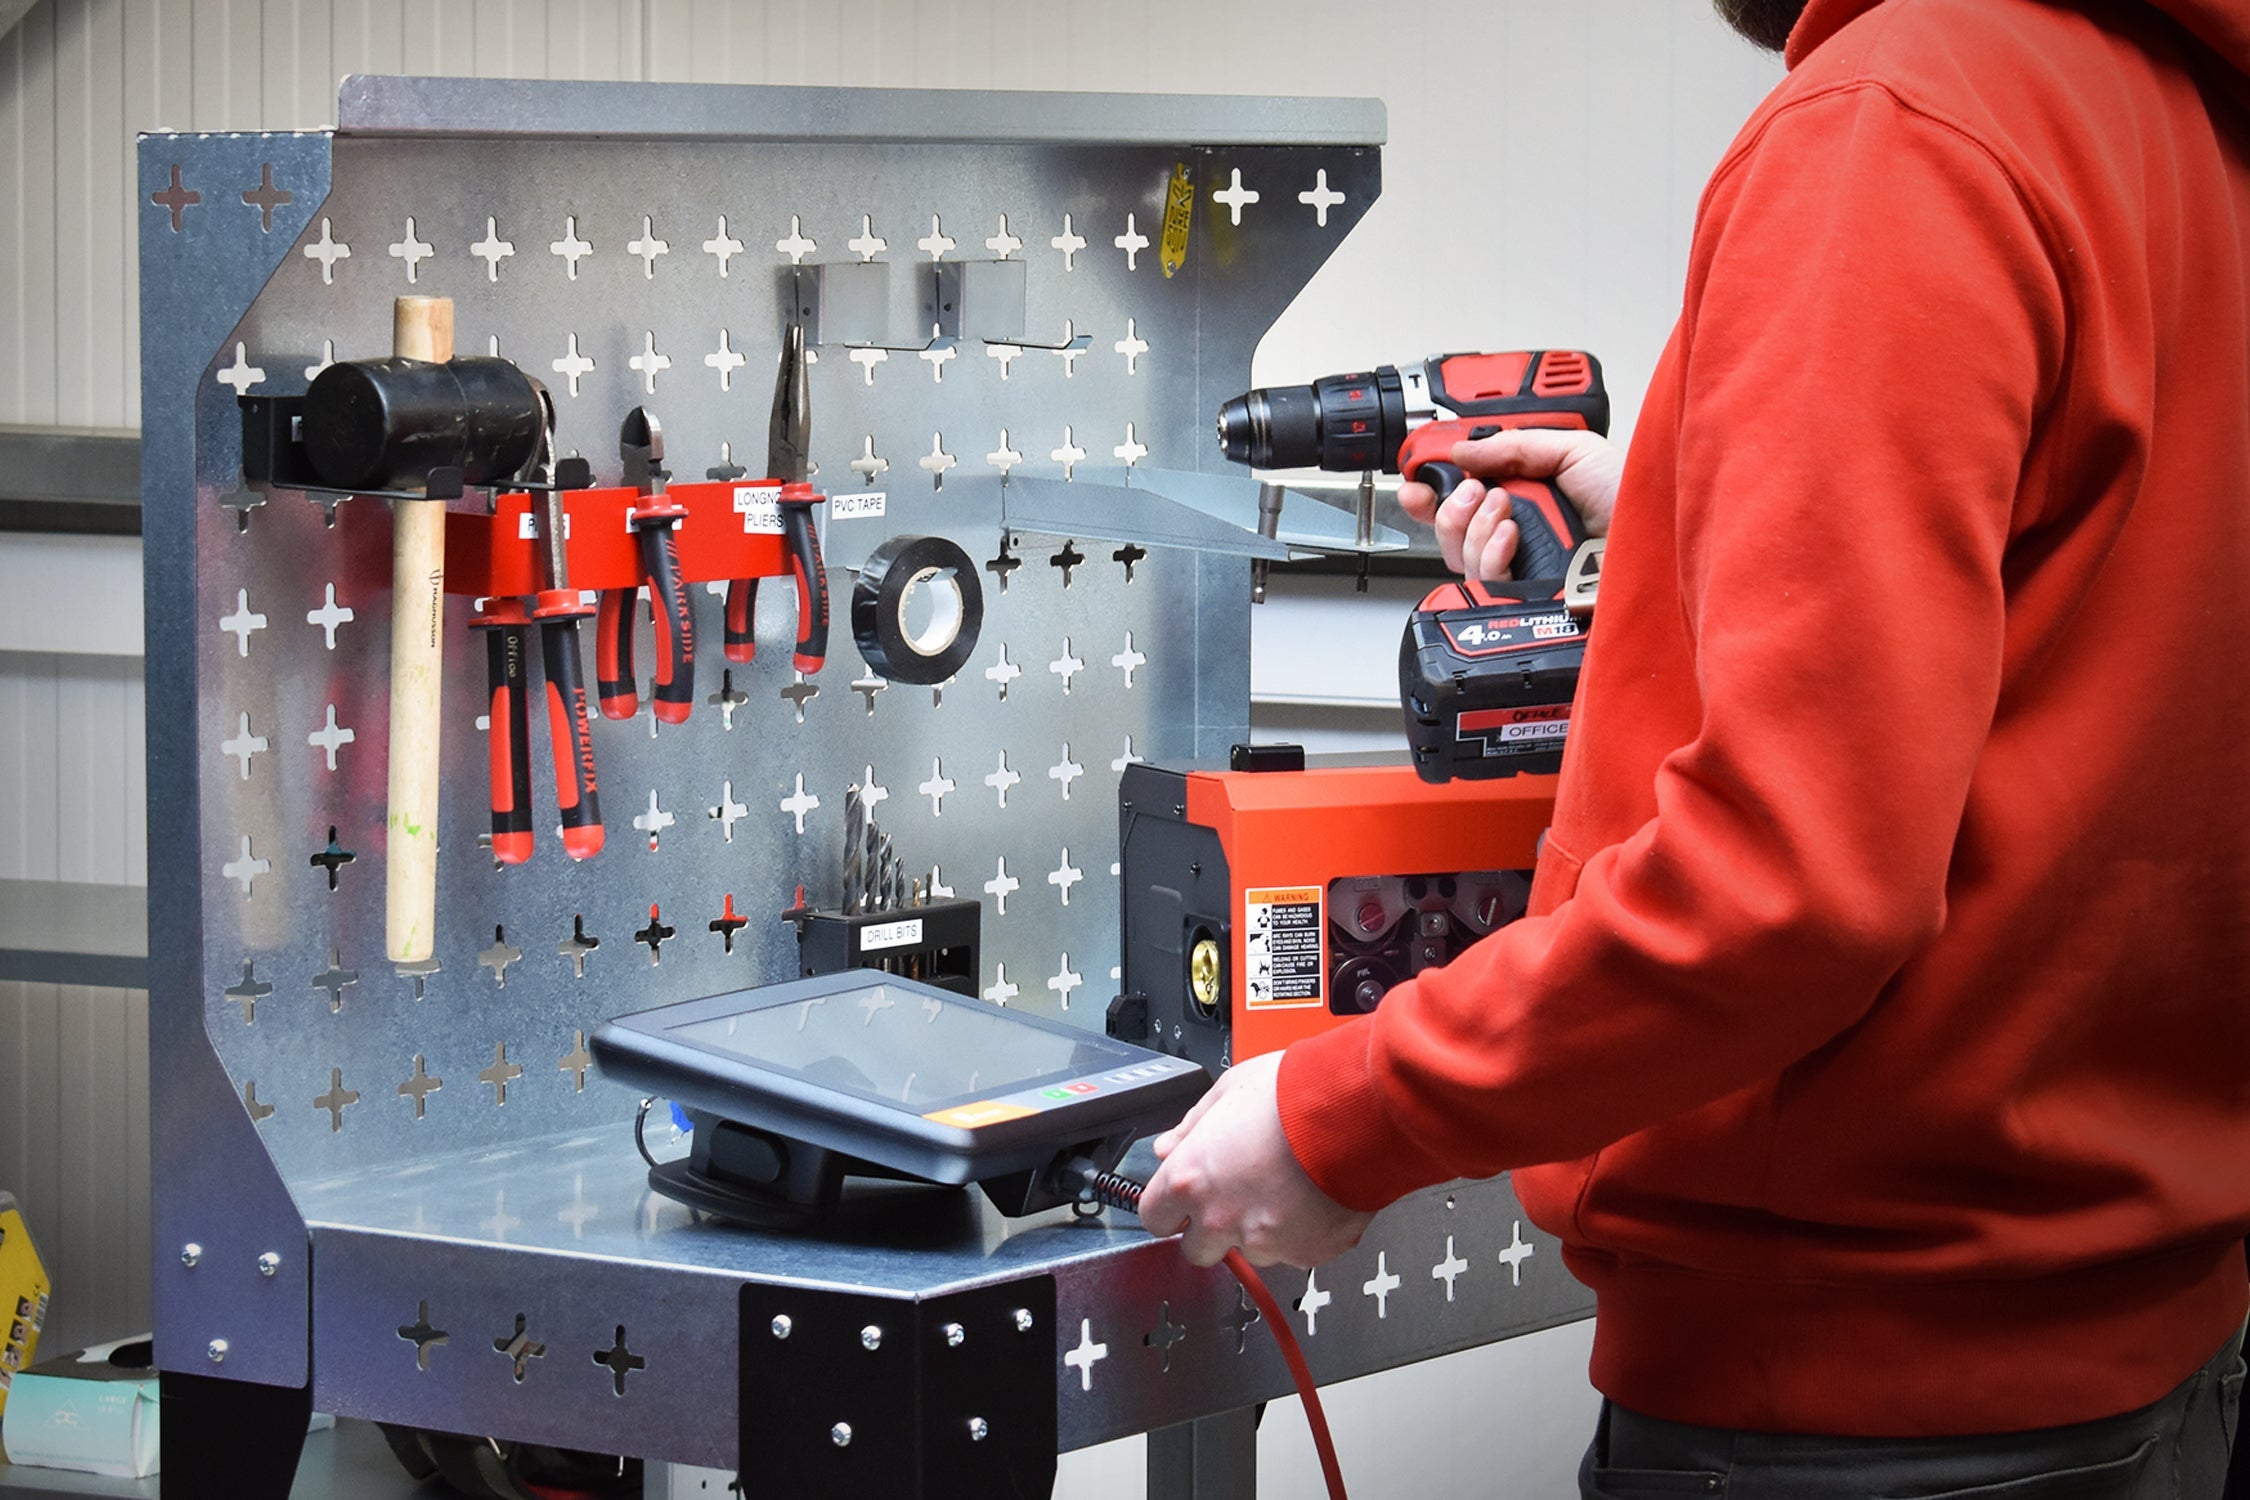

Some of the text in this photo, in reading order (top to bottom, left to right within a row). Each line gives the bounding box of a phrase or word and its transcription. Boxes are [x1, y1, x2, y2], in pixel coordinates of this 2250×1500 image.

[737, 491, 782, 506] LONGNO
[834, 496, 882, 512] PVC TAPE
[747, 513, 784, 528] PLIERS
[670, 564, 694, 663] PARKSIDE
[1488, 613, 1581, 630] REDLITHIU
[1537, 623, 1575, 636] M18
[1508, 722, 1568, 738] OFFICE
[573, 687, 599, 795] POWERFIX
[1274, 892, 1309, 902] WARNING
[867, 924, 918, 943] DRILL BITS
